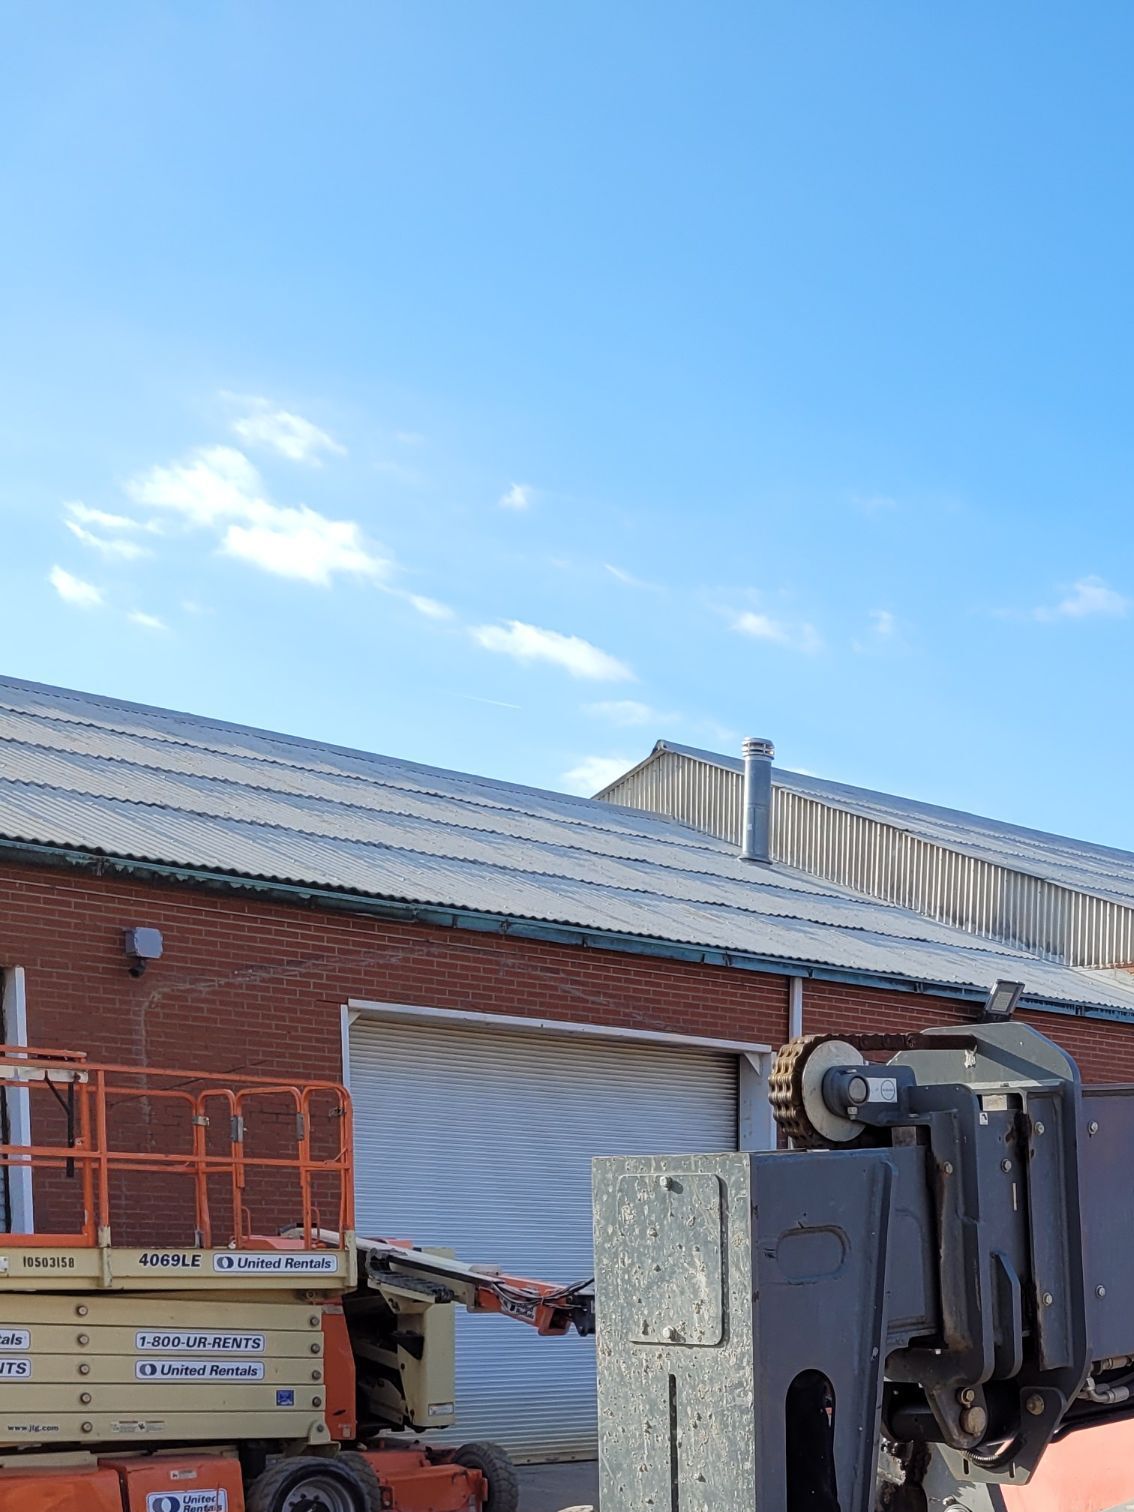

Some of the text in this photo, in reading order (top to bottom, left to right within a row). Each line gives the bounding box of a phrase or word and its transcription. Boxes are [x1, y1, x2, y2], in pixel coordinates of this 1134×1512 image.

[23, 1256, 75, 1268] 10503158
[138, 1253, 201, 1268] 4069LE
[237, 1256, 332, 1269] United Rentals
[0, 1333, 23, 1346] als
[139, 1335, 262, 1350] 1-800-UR-RENTS
[160, 1363, 258, 1377] United Rentals
[8, 1423, 59, 1433] www.jlg.com
